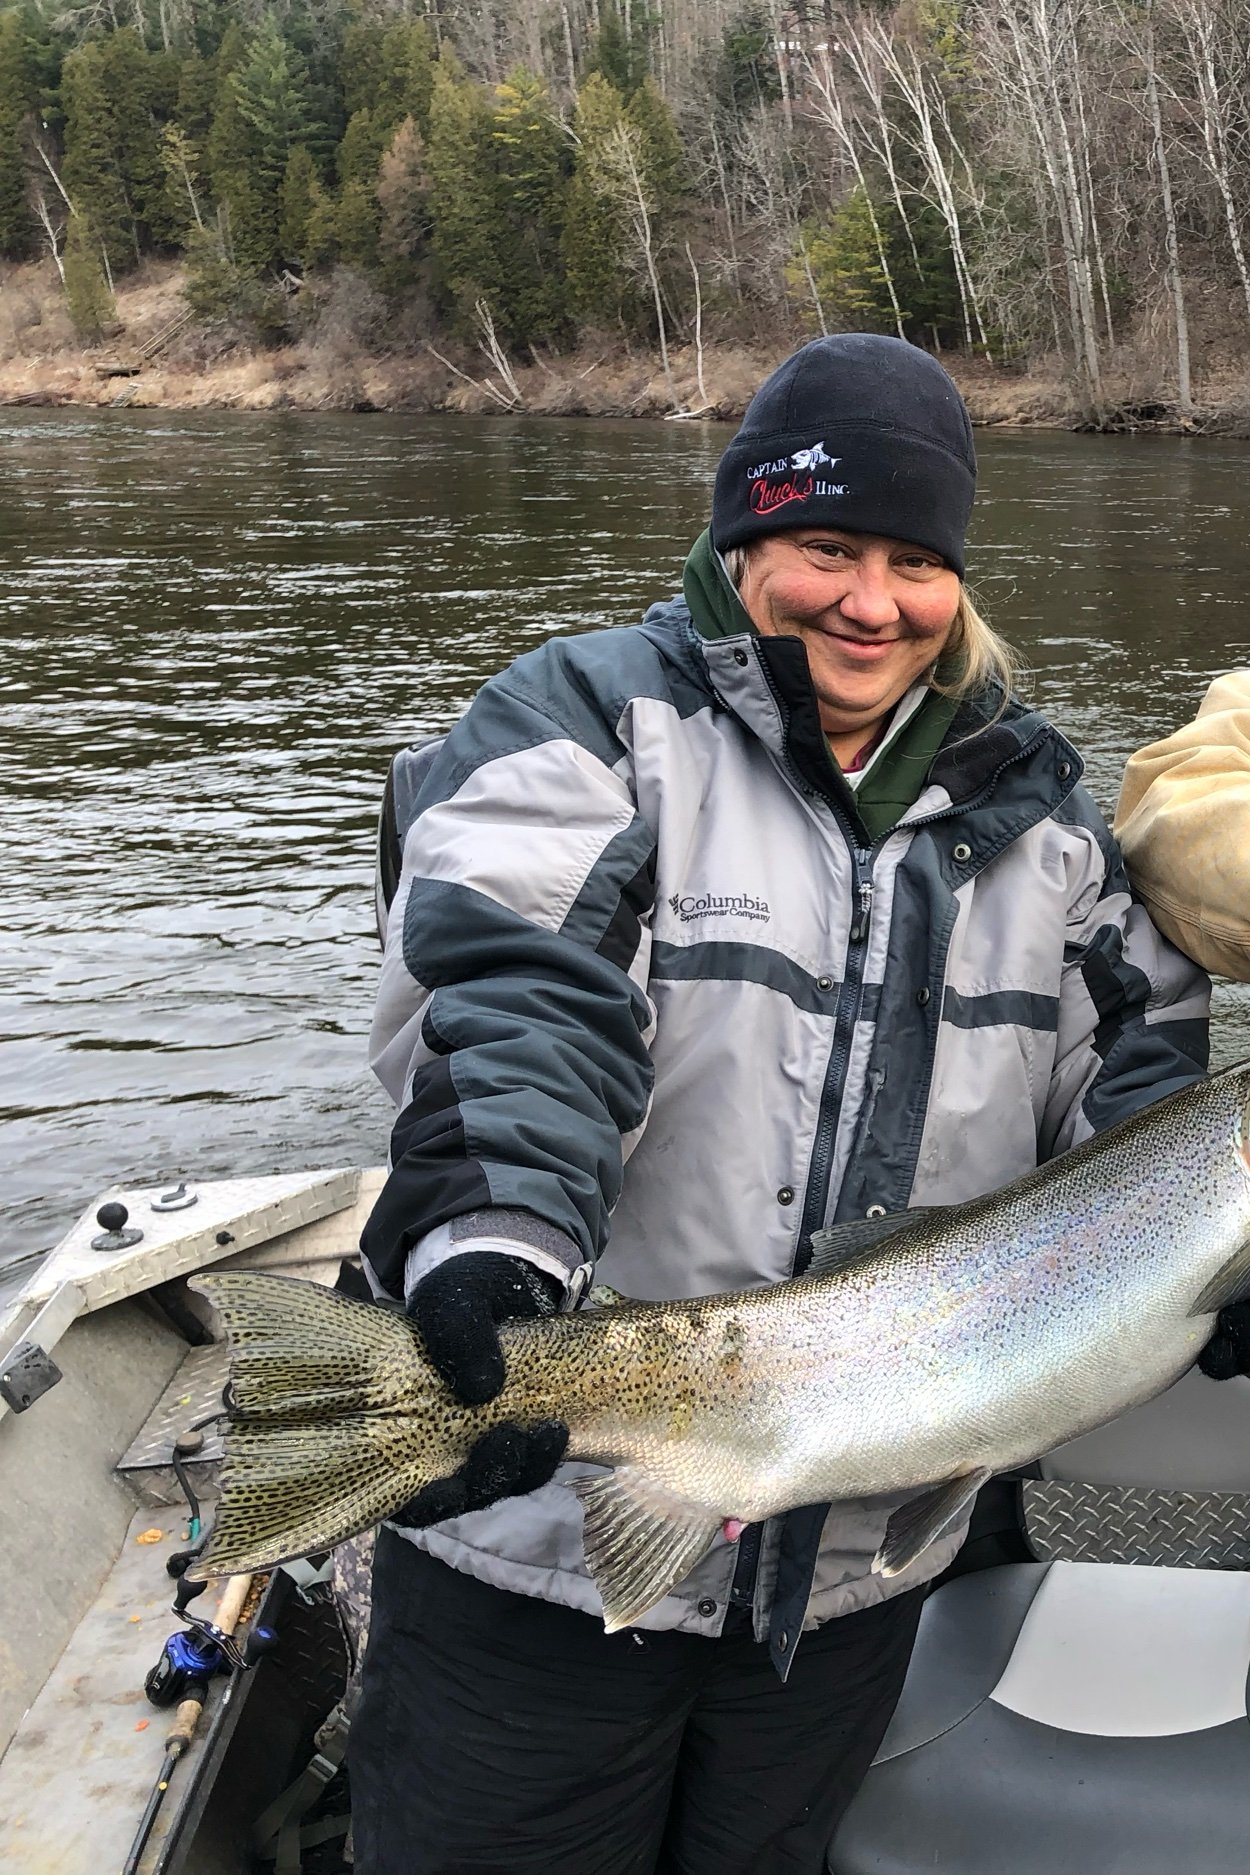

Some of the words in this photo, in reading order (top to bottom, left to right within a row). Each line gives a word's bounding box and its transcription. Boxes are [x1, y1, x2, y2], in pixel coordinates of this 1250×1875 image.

[746, 457, 788, 479] CAPTAIN
[680, 893, 771, 914] Columbia
[680, 909, 729, 923] Sportswear
[729, 908, 771, 923] Company
